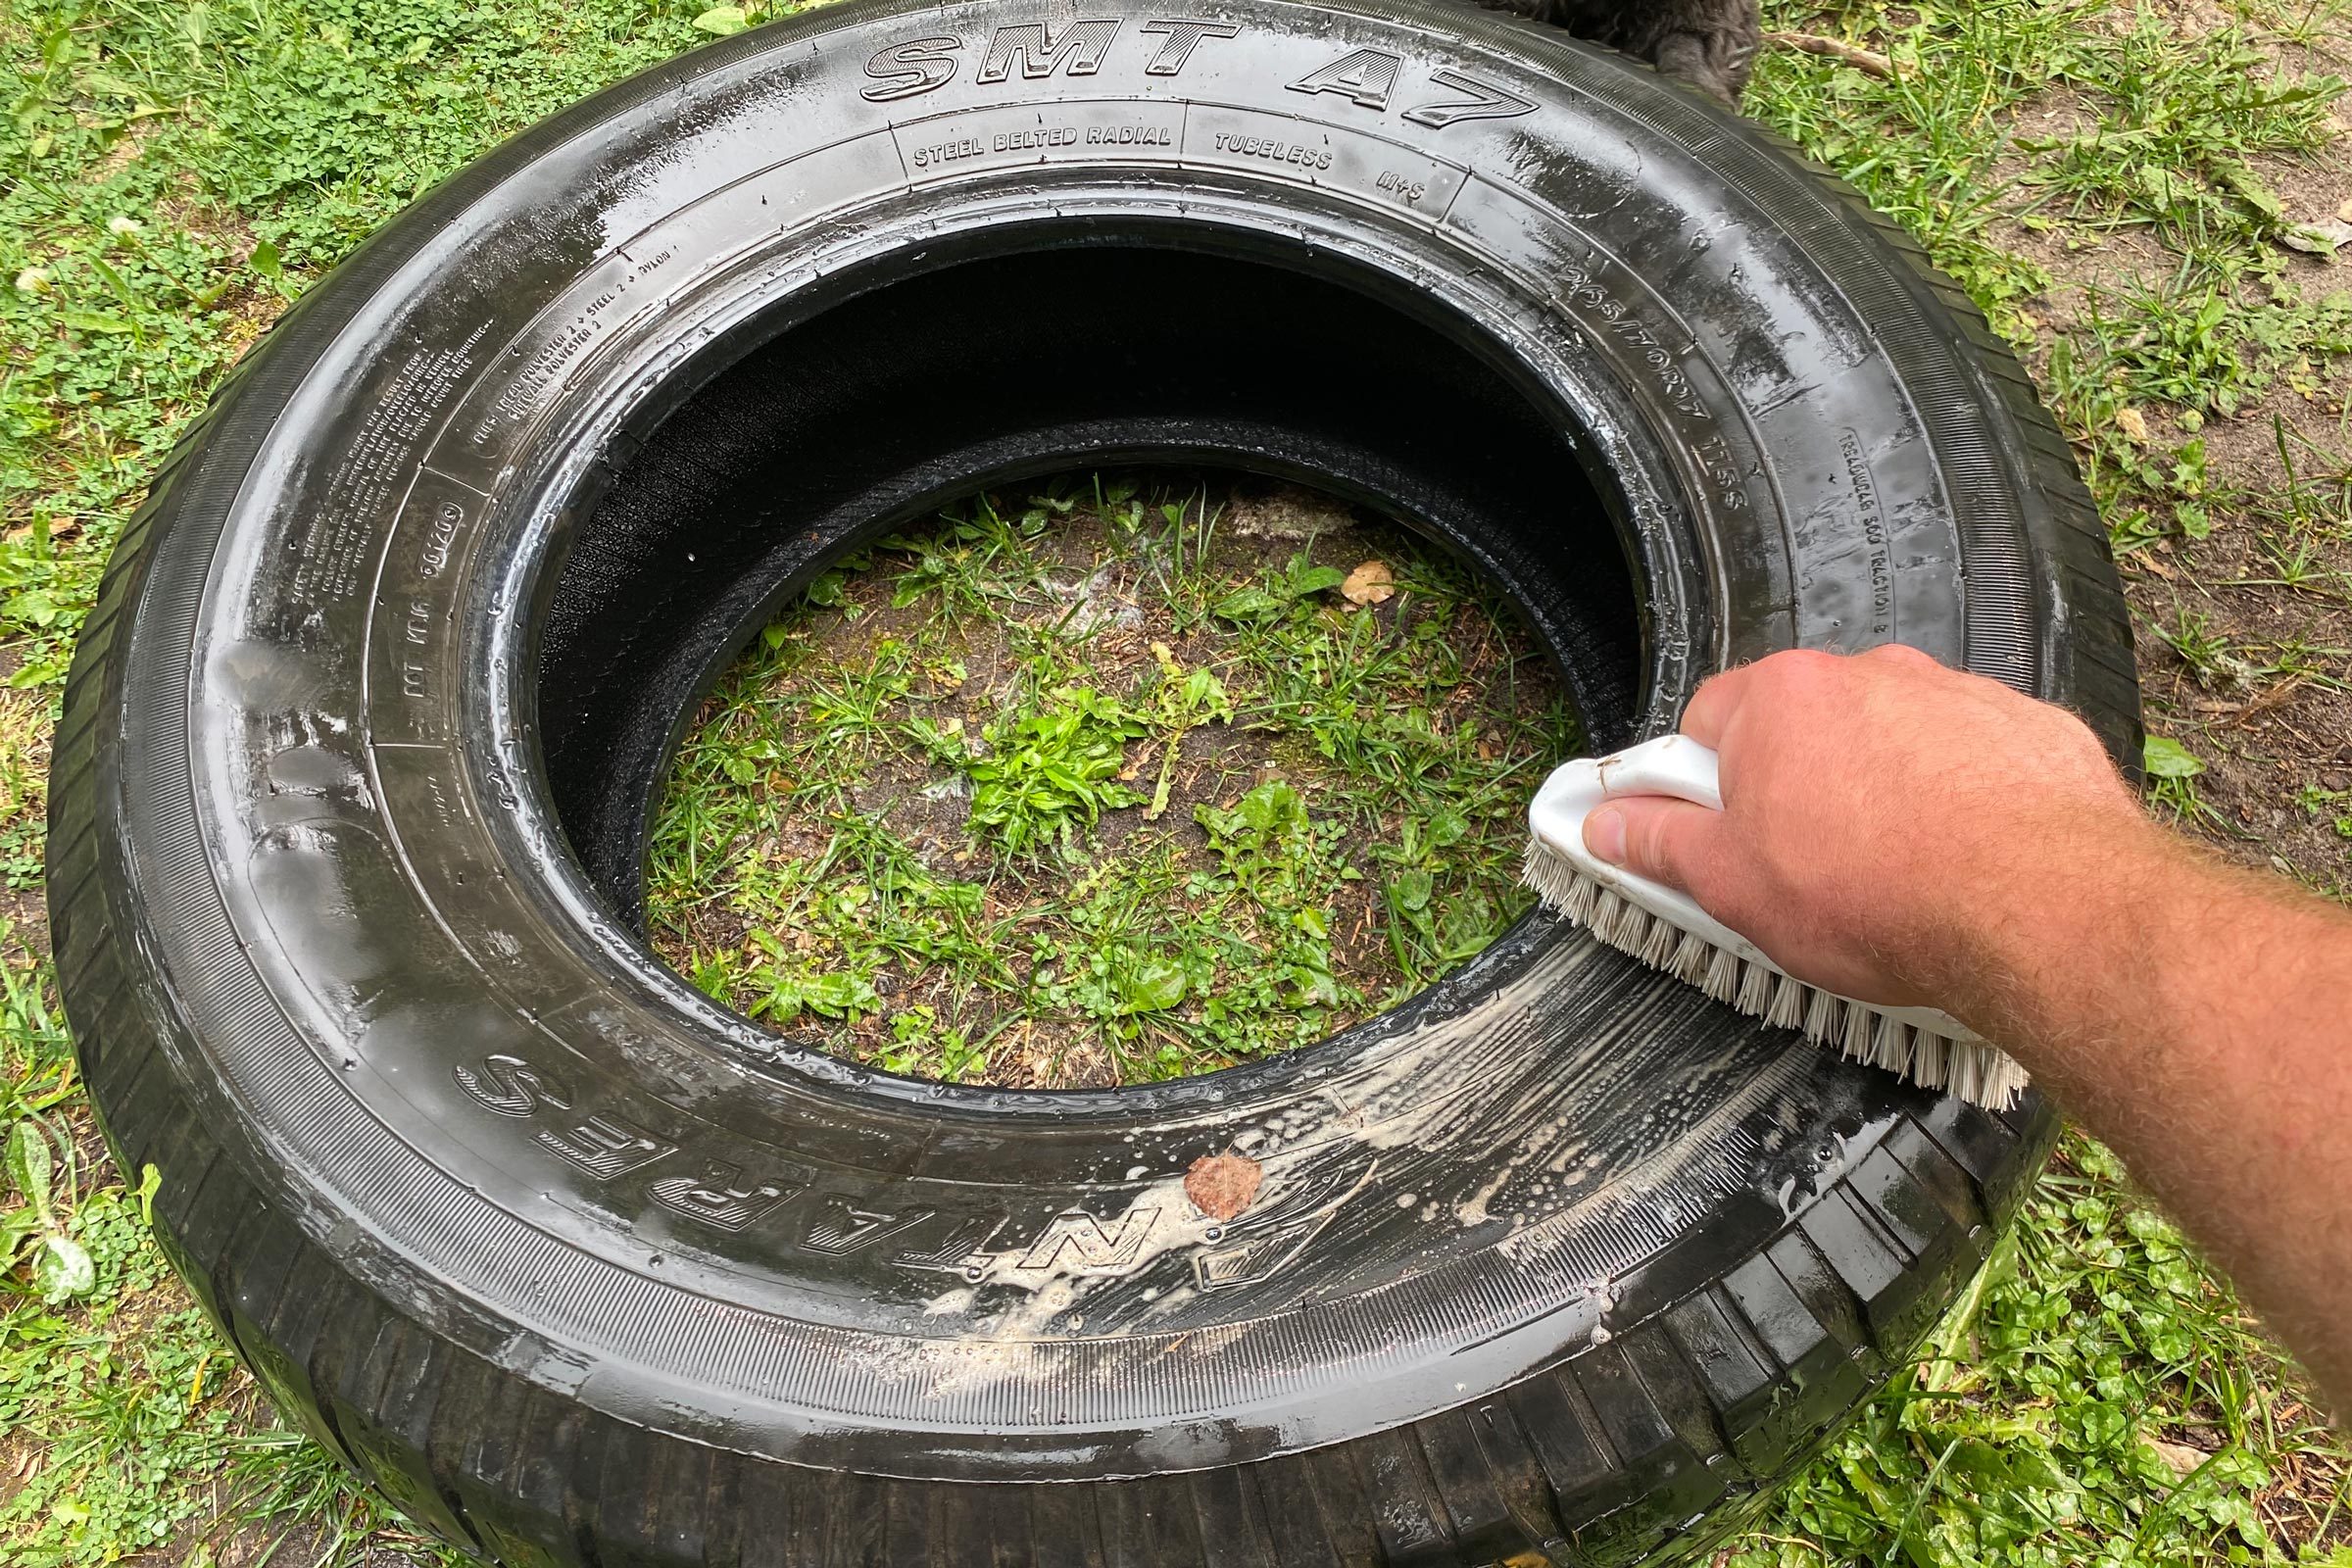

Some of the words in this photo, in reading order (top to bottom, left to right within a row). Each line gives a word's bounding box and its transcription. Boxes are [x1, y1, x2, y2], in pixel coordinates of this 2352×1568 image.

[859, 18, 1243, 102] SMT
[1284, 48, 1542, 128] A7
[913, 137, 985, 166] STEEL
[994, 126, 1078, 152] BELTED
[1086, 126, 1171, 146] RADIAL
[1215, 132, 1333, 171] TUBELESS
[1376, 171, 1426, 201] M+S
[495, 381, 524, 412] TREAD
[519, 333, 567, 382] POLYESTER
[585, 292, 615, 316] STEEL
[616, 283, 626, 293] 2
[638, 251, 670, 275] NYLON
[1553, 267, 1712, 419] 265/70R17
[424, 348, 454, 380] VEHICLE
[429, 381, 454, 408] MOUNT
[451, 357, 473, 378] TIRES
[507, 373, 548, 420] SIDEWALL
[543, 327, 592, 375] POLYESTER
[591, 320, 602, 330] 2
[378, 375, 404, 408] RESULT
[411, 405, 423, 417] TO
[420, 365, 453, 403] IMPROPER
[404, 661, 424, 697] DOT
